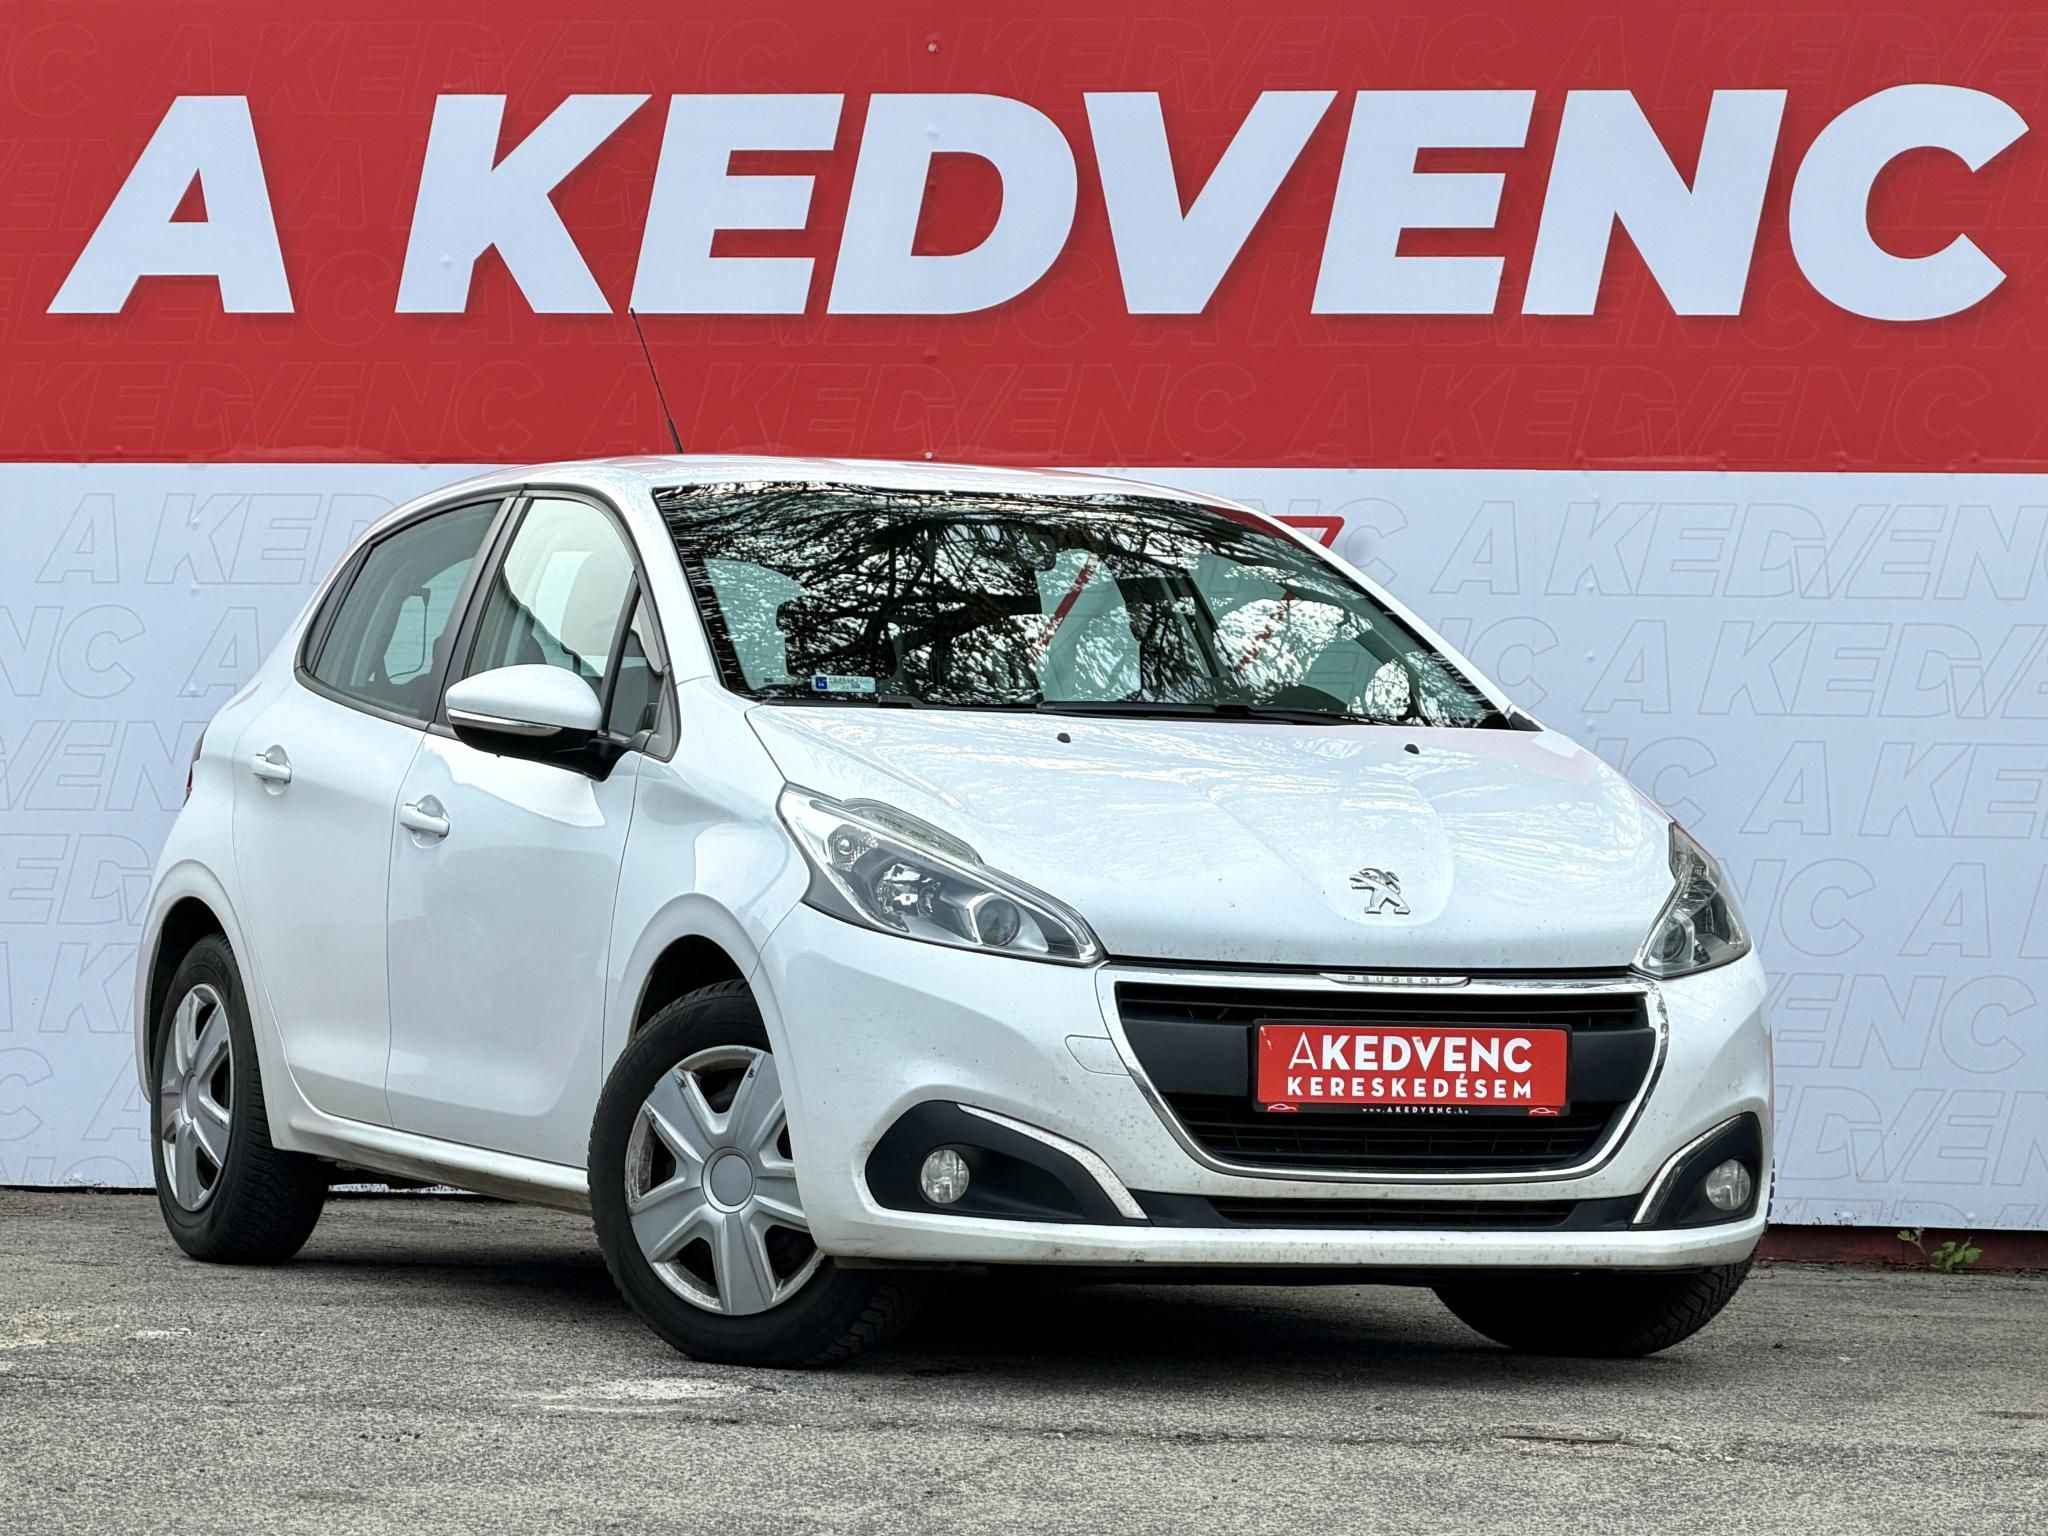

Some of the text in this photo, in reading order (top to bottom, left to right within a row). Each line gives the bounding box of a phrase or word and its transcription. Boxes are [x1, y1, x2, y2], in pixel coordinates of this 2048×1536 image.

[0, 22, 100, 118] C
[48, 94, 295, 315] A
[393, 83, 2032, 322] KEDVENC
[688, 362, 1257, 459] KEDVENC
[1288, 363, 1375, 460] A
[1399, 364, 1993, 464] KEDVENC
[35, 492, 121, 584] A
[1429, 499, 1521, 596] A
[1543, 501, 2048, 601] KEDVEN
[177, 607, 263, 698] A
[1581, 619, 1672, 714] A
[1738, 740, 1832, 836] A
[1896, 861, 1991, 958] A
[1346, 975, 1443, 985] PEUGEOT
[1286, 1073, 1532, 1099] KERESKEDÉSEM
